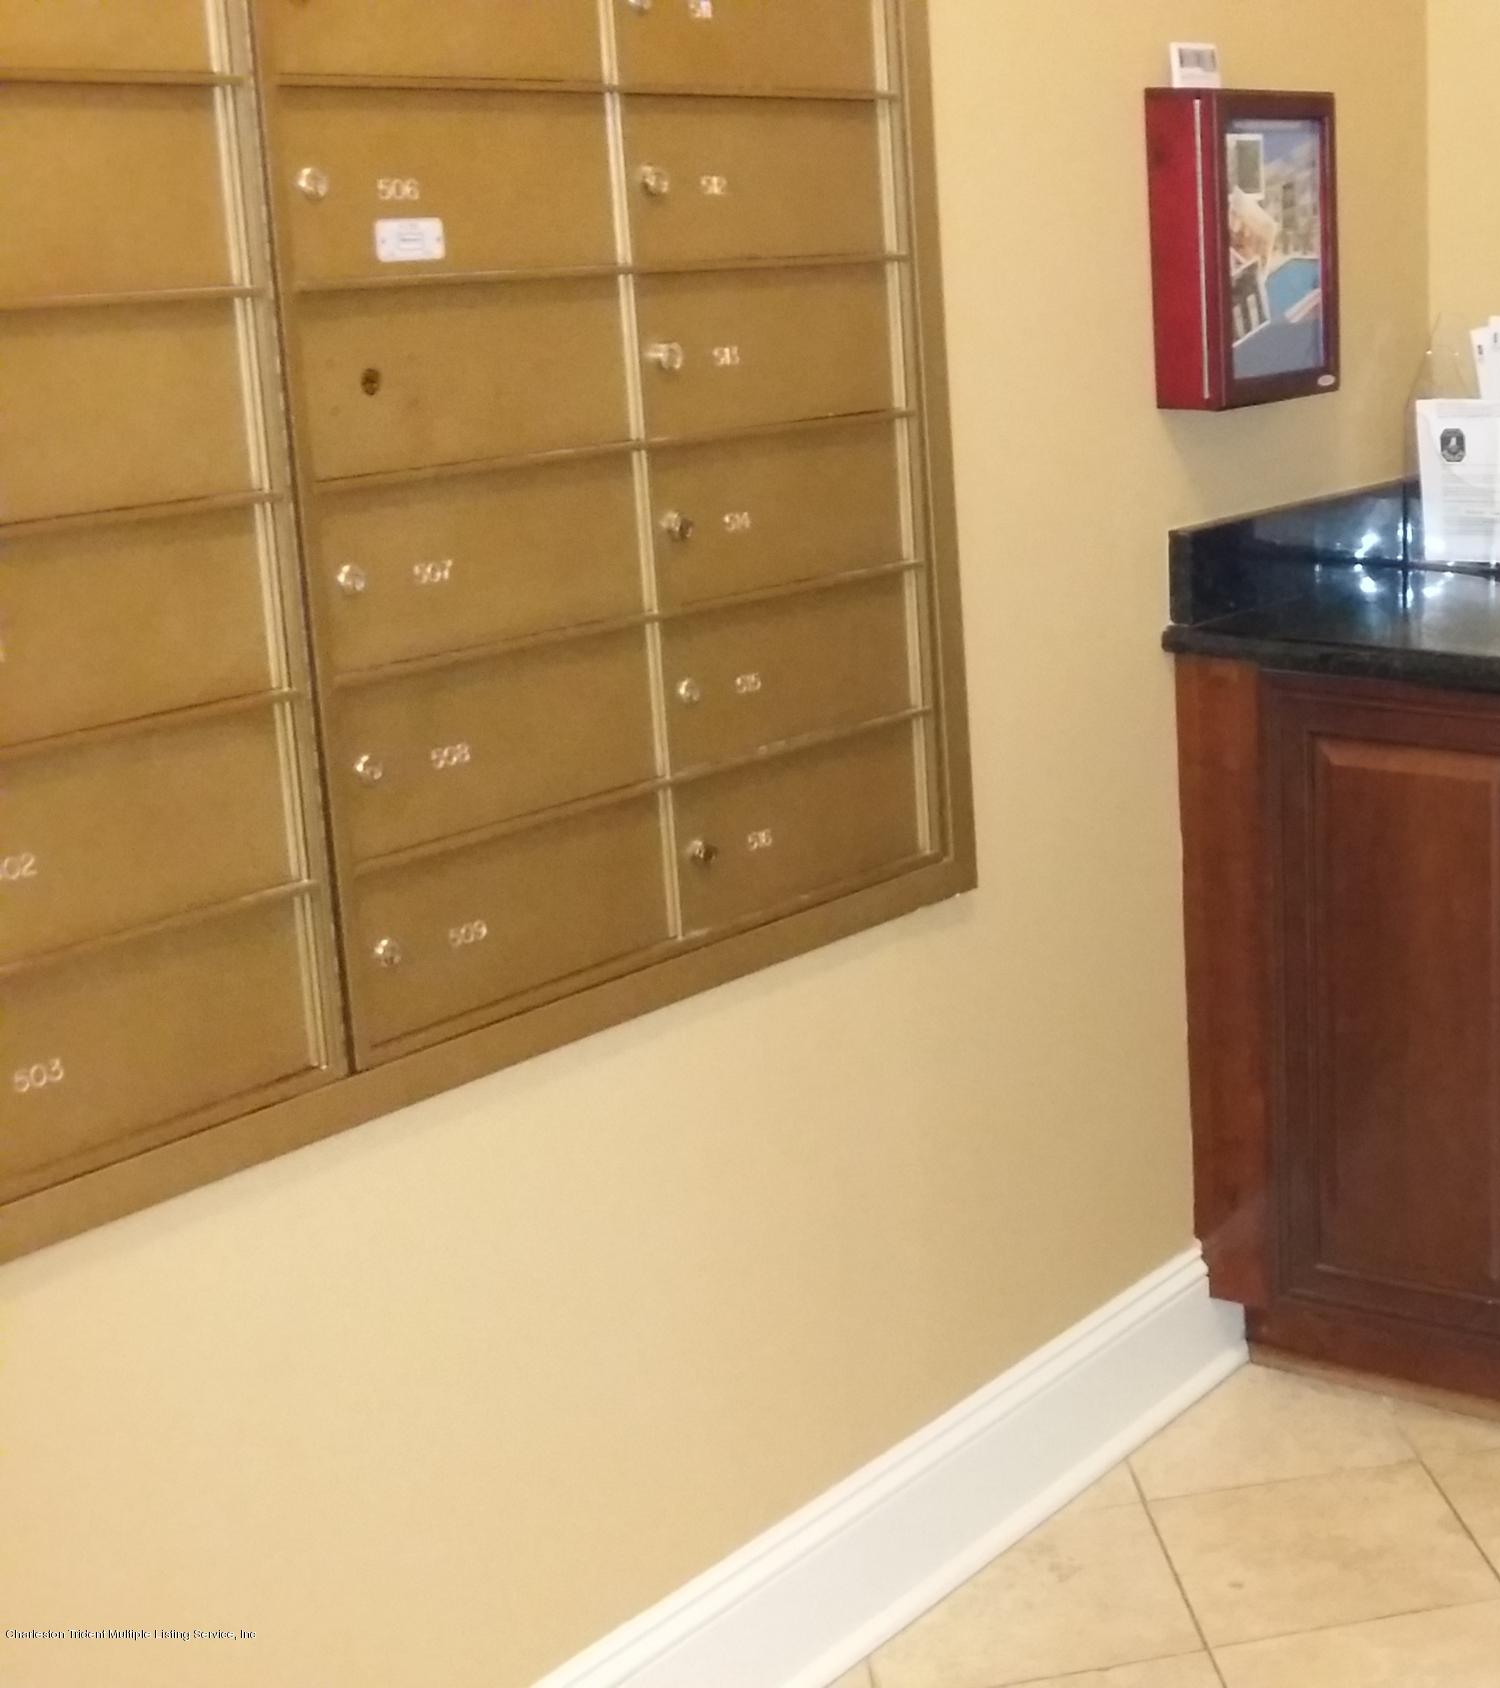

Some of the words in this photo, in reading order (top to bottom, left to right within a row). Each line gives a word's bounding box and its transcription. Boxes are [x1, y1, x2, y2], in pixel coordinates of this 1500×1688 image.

[376, 178, 420, 200] 506
[412, 558, 454, 584] 507
[735, 671, 762, 694] 515
[430, 742, 472, 769] 508
[747, 828, 773, 851] 516
[0, 853, 38, 880] 02
[448, 919, 488, 949] 509
[13, 1057, 65, 1093] 503
